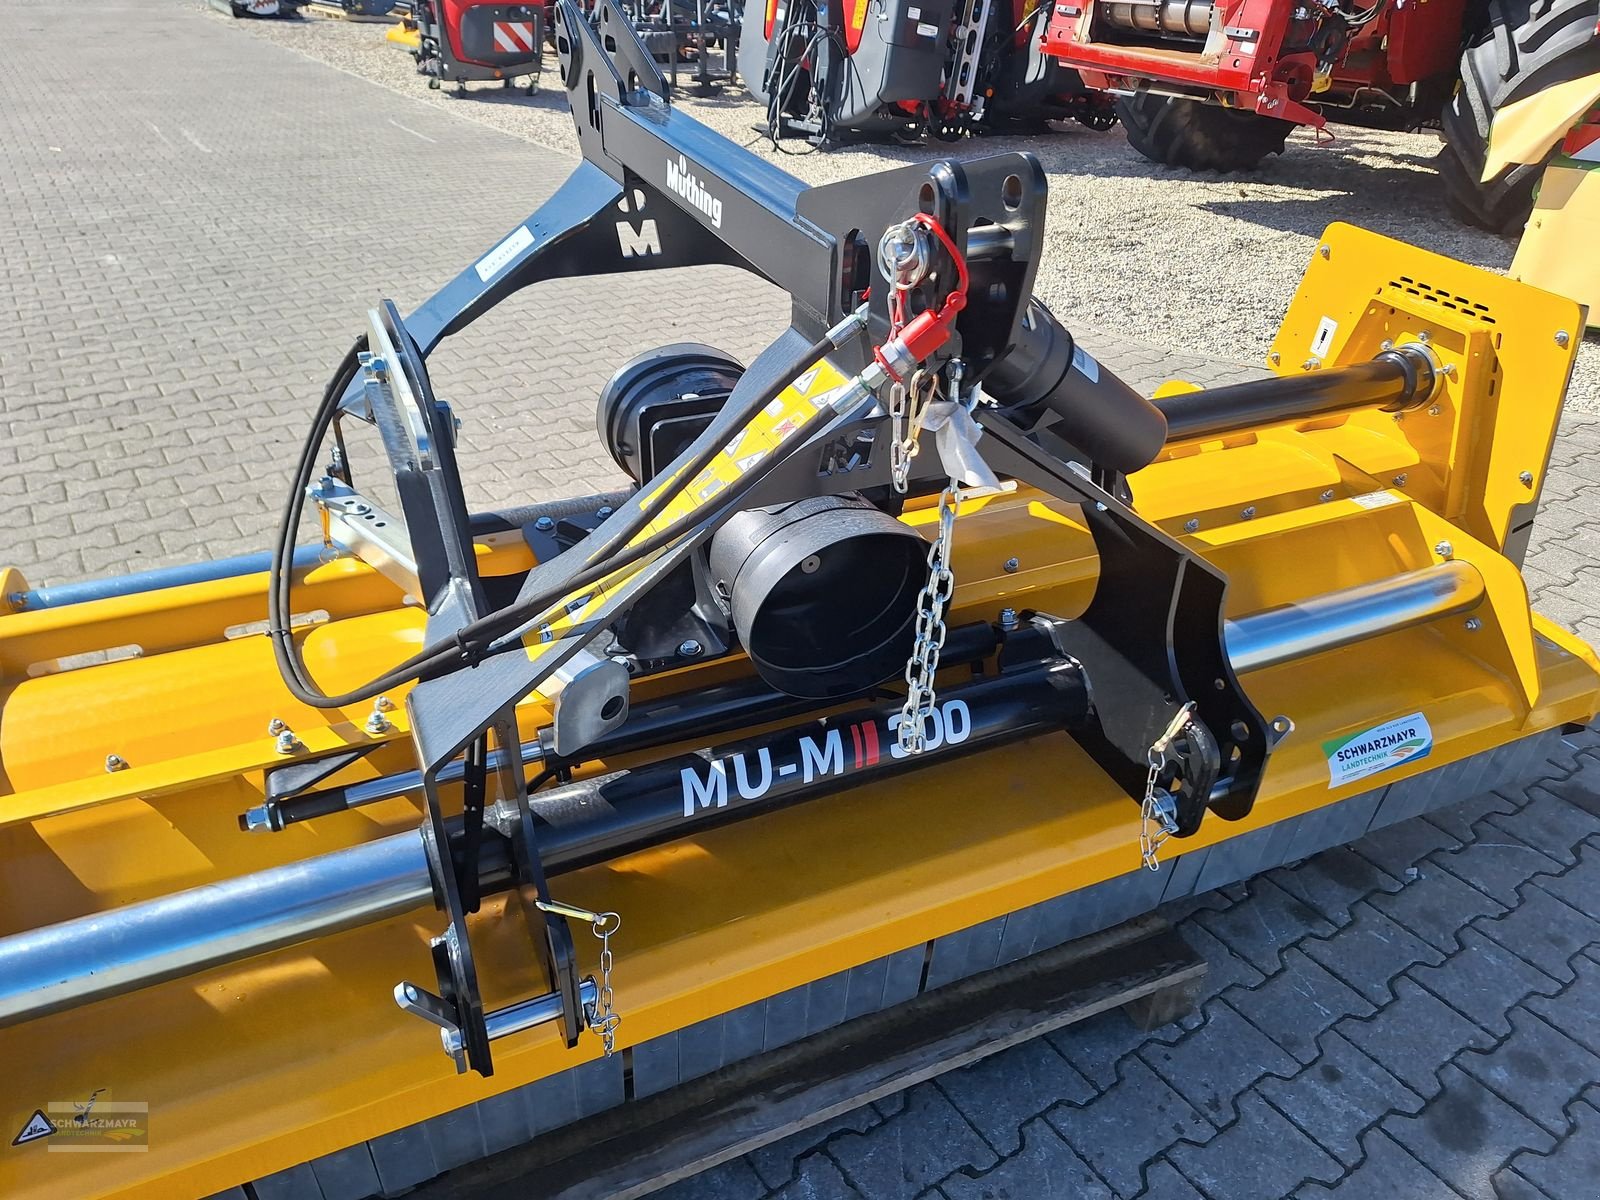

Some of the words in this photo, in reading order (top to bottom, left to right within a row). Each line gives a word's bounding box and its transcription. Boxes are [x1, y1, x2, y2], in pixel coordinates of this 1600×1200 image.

[666, 154, 723, 229] Müthing
[1337, 728, 1416, 762] SCHWARZMAYR
[1342, 751, 1389, 772] LANDTECHNIK
